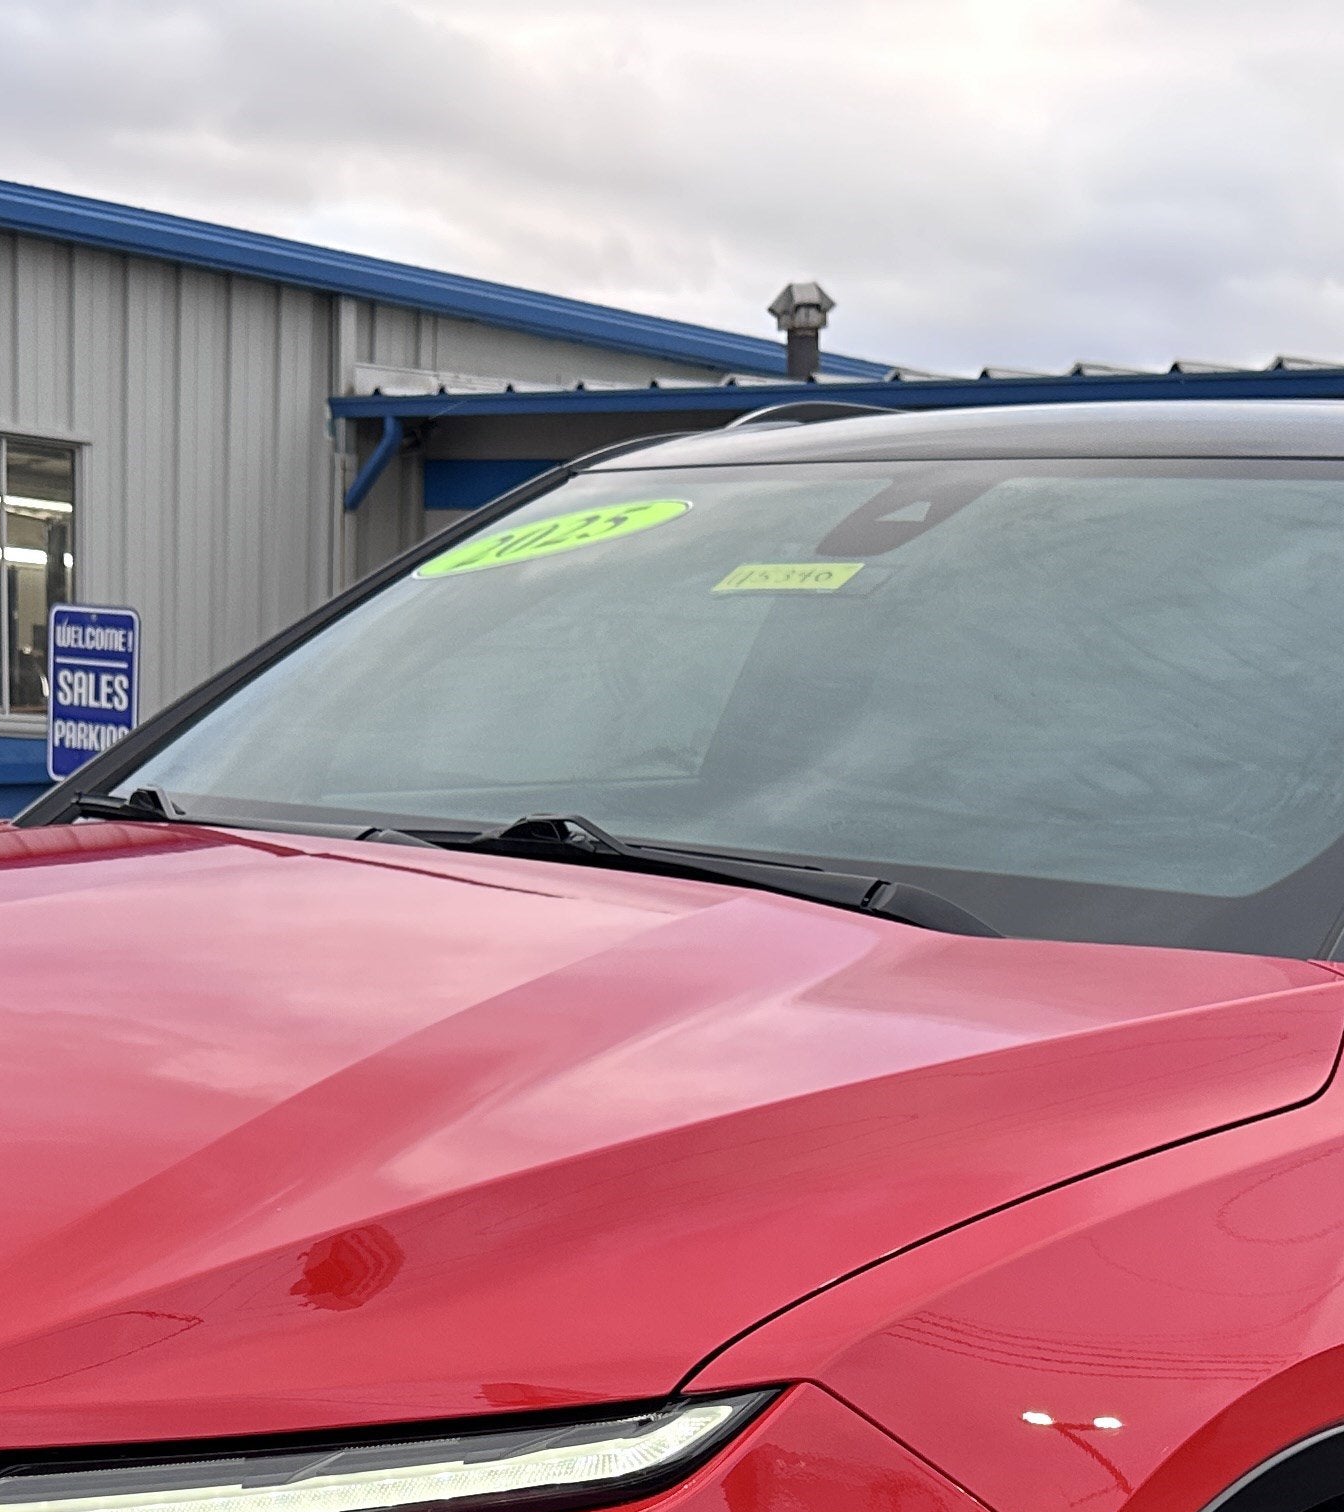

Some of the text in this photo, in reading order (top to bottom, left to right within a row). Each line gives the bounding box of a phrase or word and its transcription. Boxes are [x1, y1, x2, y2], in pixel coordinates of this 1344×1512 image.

[444, 504, 654, 571] 2025
[56, 617, 134, 653] WELCOME!
[57, 668, 130, 712] SALES
